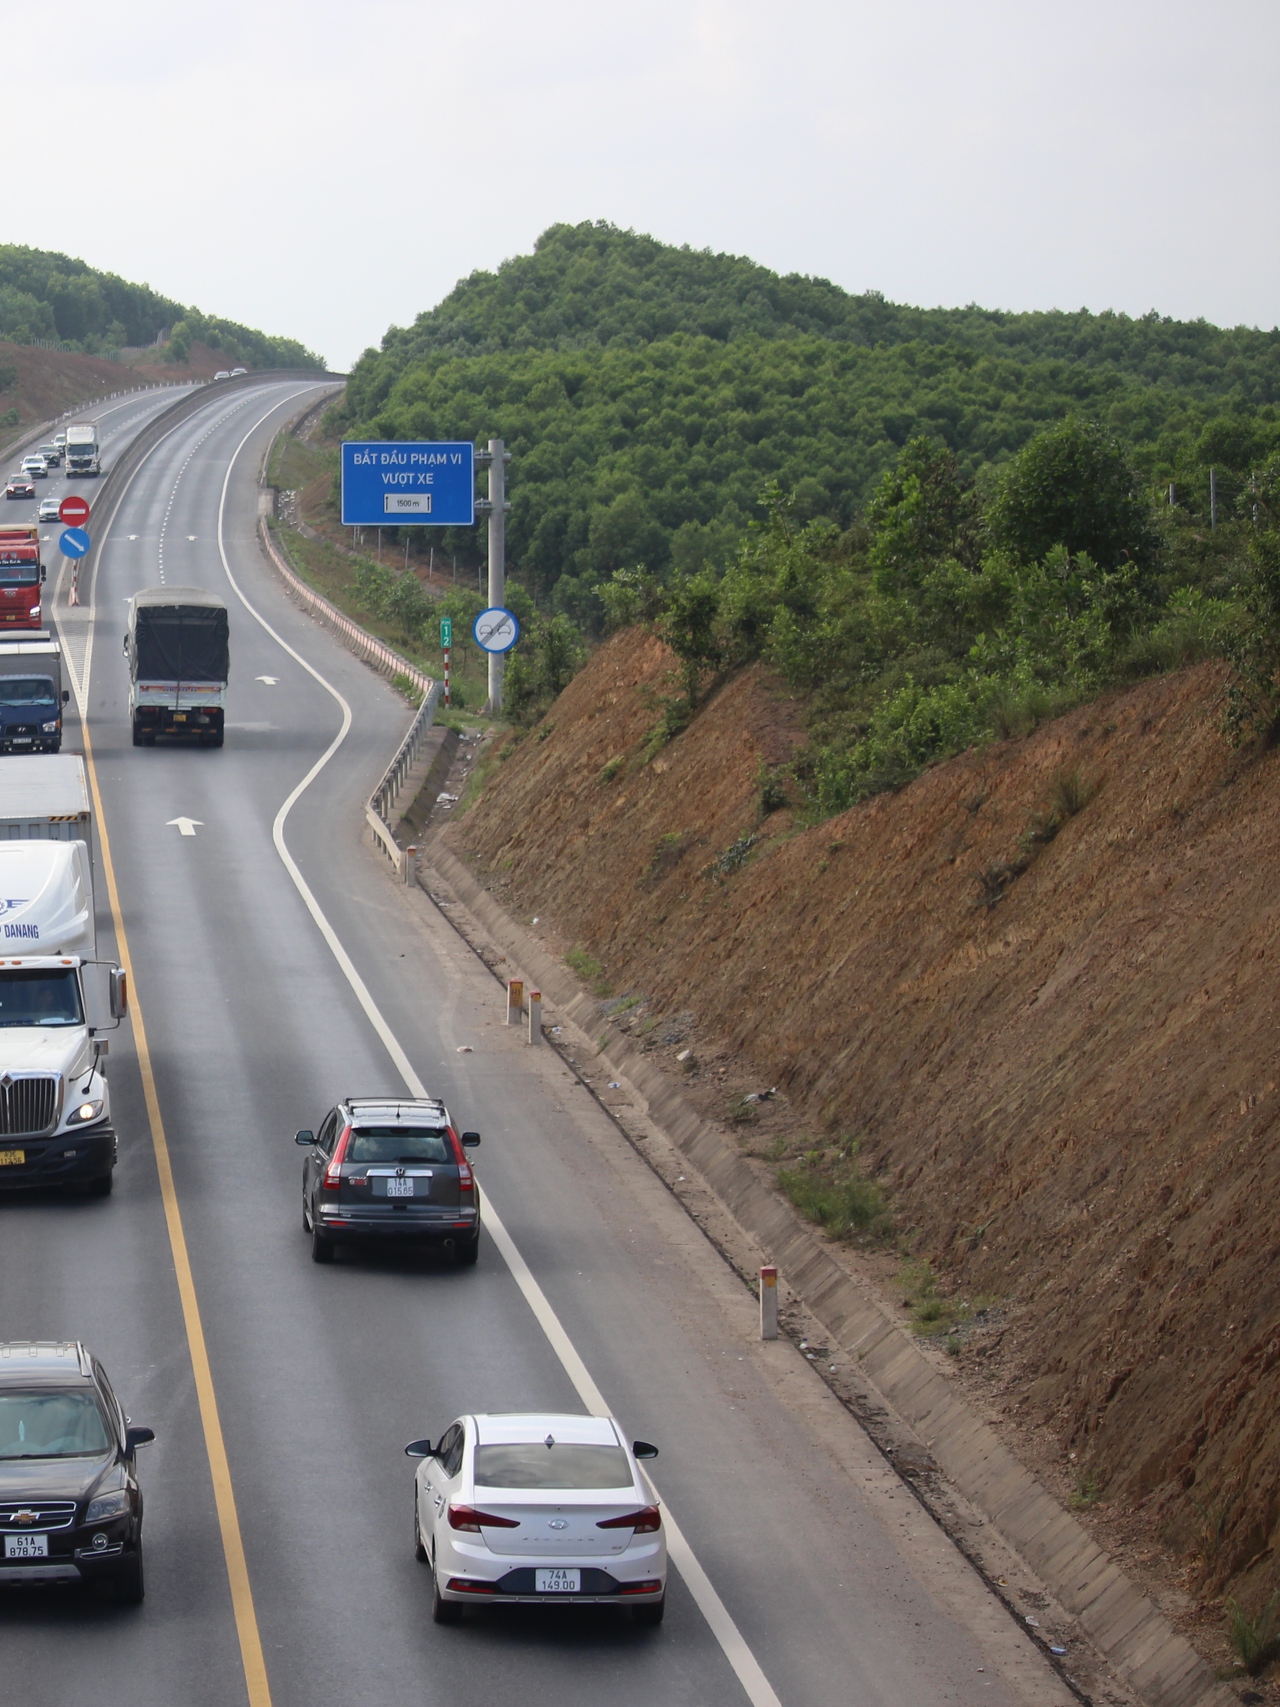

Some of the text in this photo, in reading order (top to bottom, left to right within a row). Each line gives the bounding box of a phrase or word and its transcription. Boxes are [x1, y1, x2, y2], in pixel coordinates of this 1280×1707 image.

[353, 449, 462, 468] BẮT ĐẦU PHẠM VI
[381, 472, 434, 487] VƯỢT XE
[444, 626, 448, 635] 1
[443, 636, 450, 646] 2
[4, 923, 39, 939] DANANG
[16, 1537, 36, 1546] 61A
[9, 1546, 44, 1556] 878.75
[548, 1570, 568, 1580] 74A
[542, 1580, 576, 1590] 149.00
